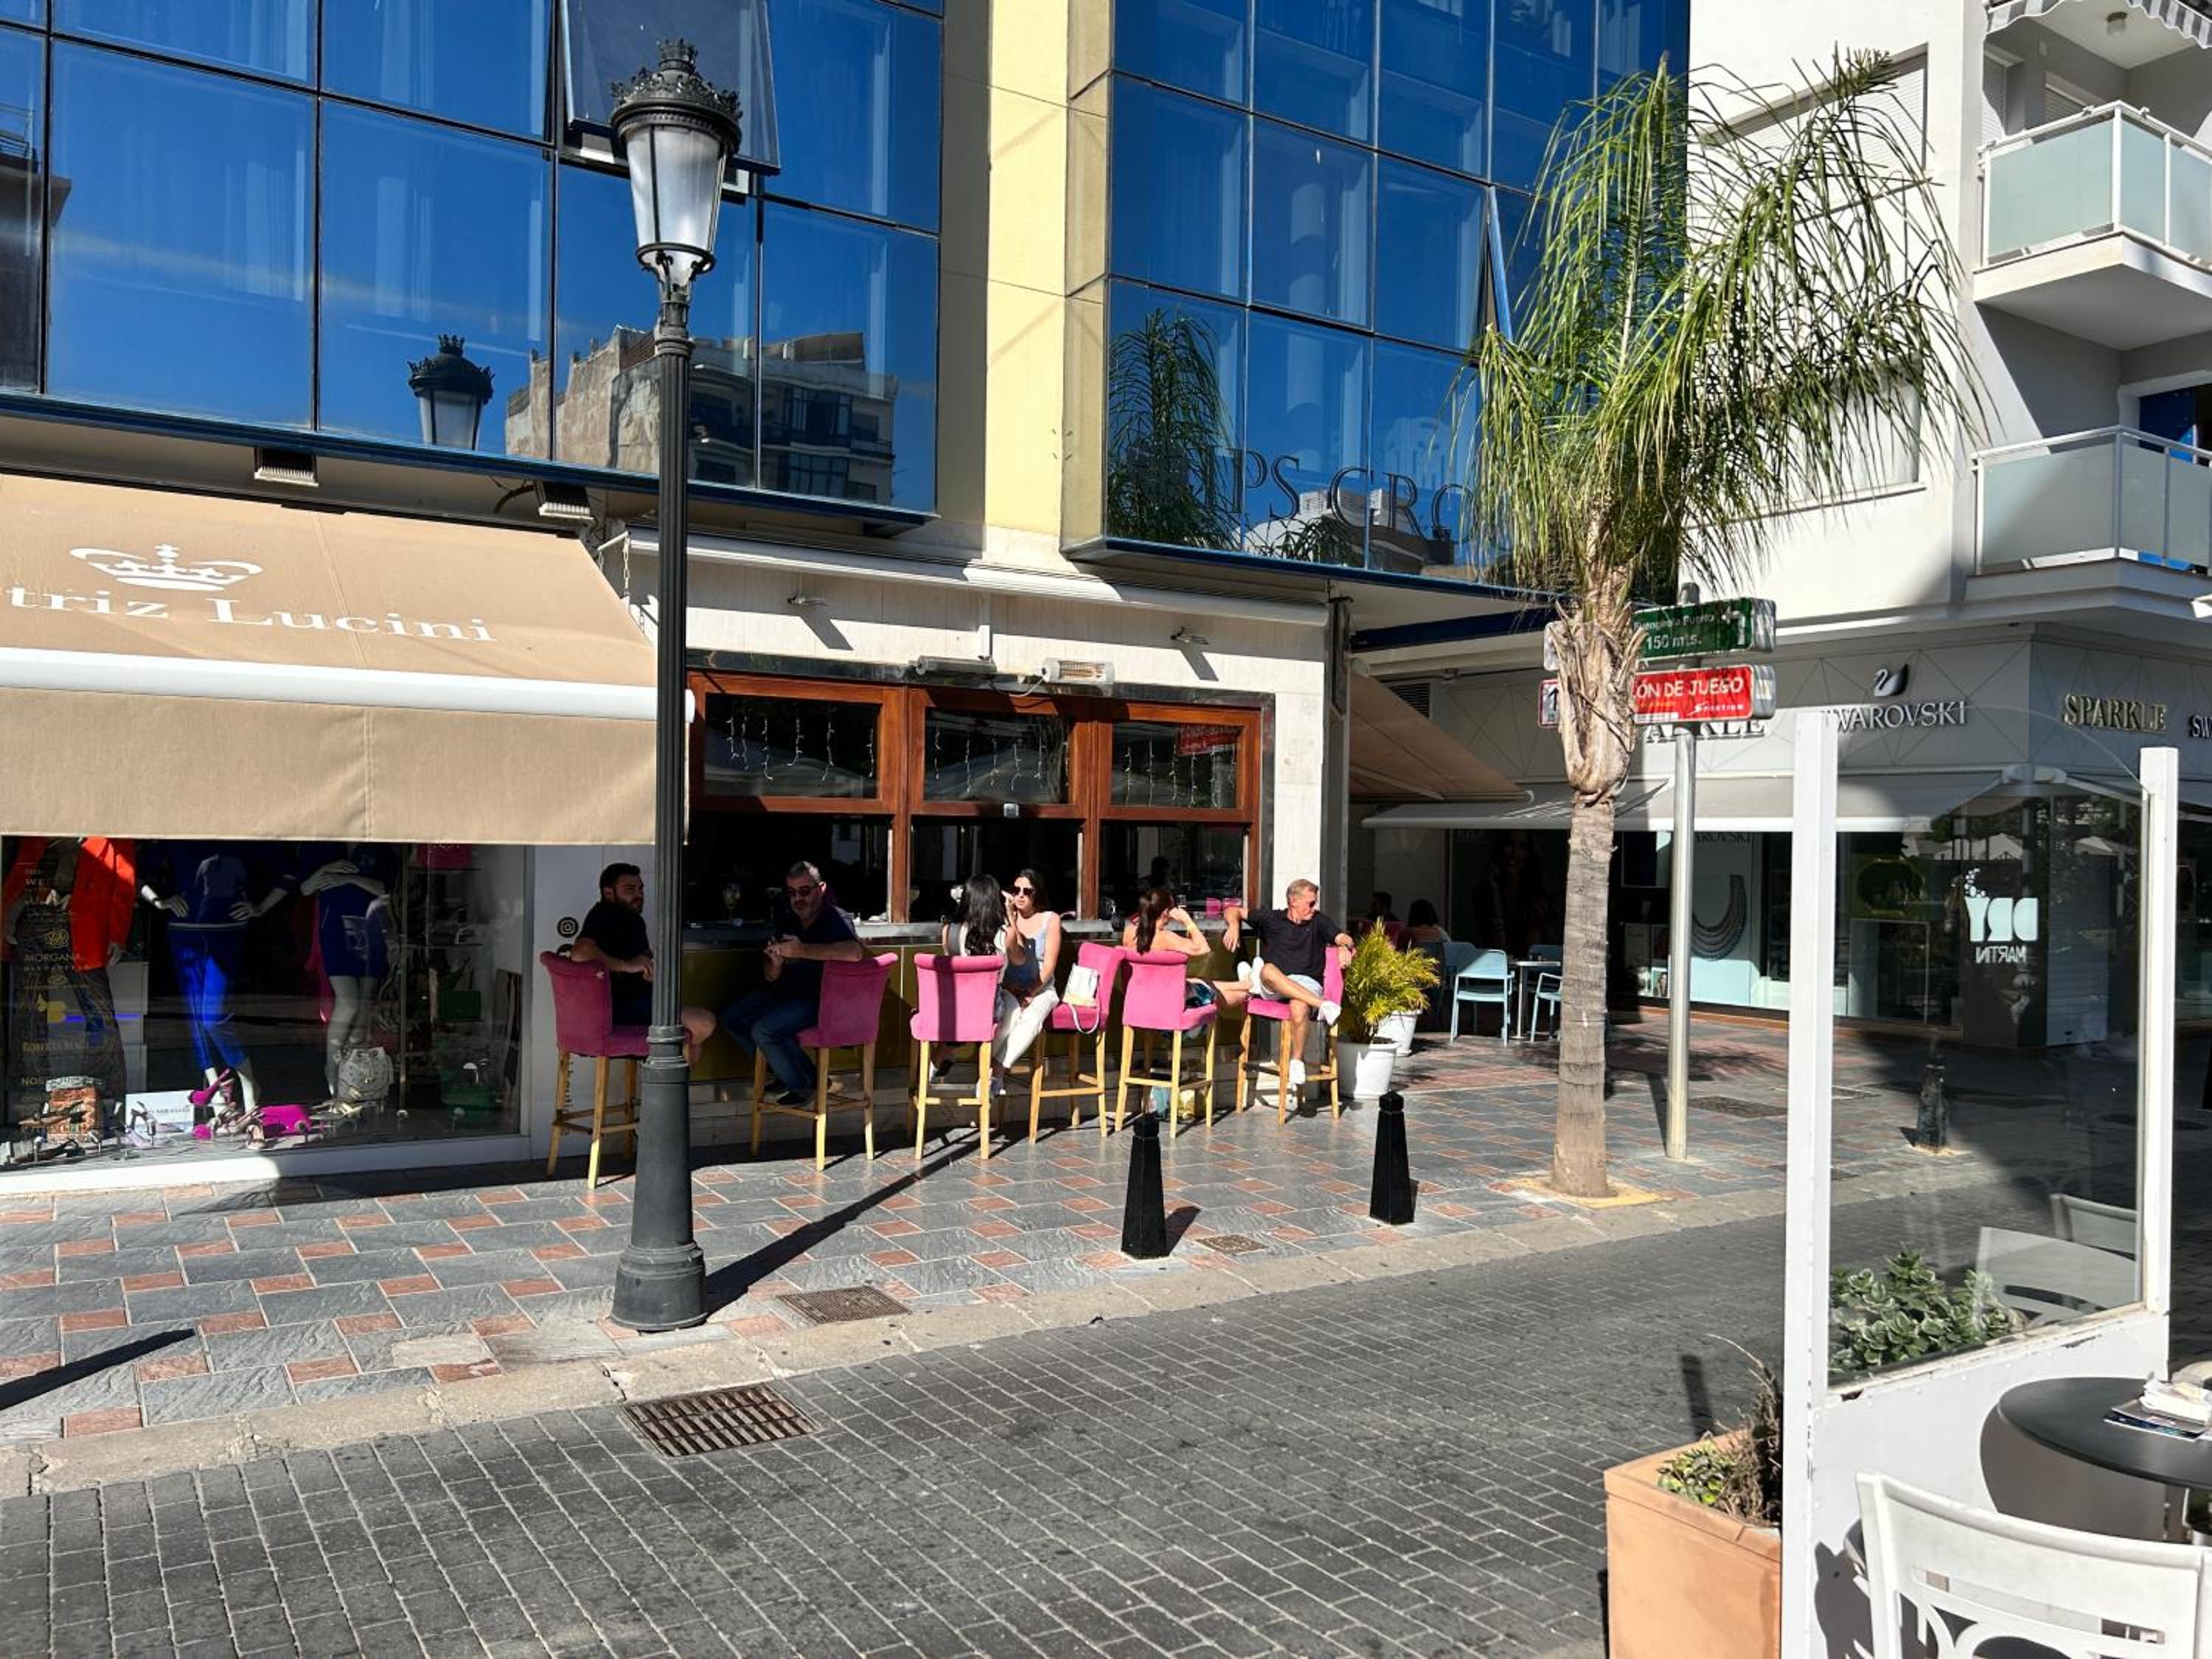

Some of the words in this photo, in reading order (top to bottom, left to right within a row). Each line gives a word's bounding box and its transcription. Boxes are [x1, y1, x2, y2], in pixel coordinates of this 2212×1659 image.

[205, 598, 497, 641] Lucini
[1646, 635, 1669, 650] 150
[1664, 680, 1685, 698] DE
[1688, 676, 1745, 696] JUEGO
[2063, 693, 2167, 732] SPARKLE
